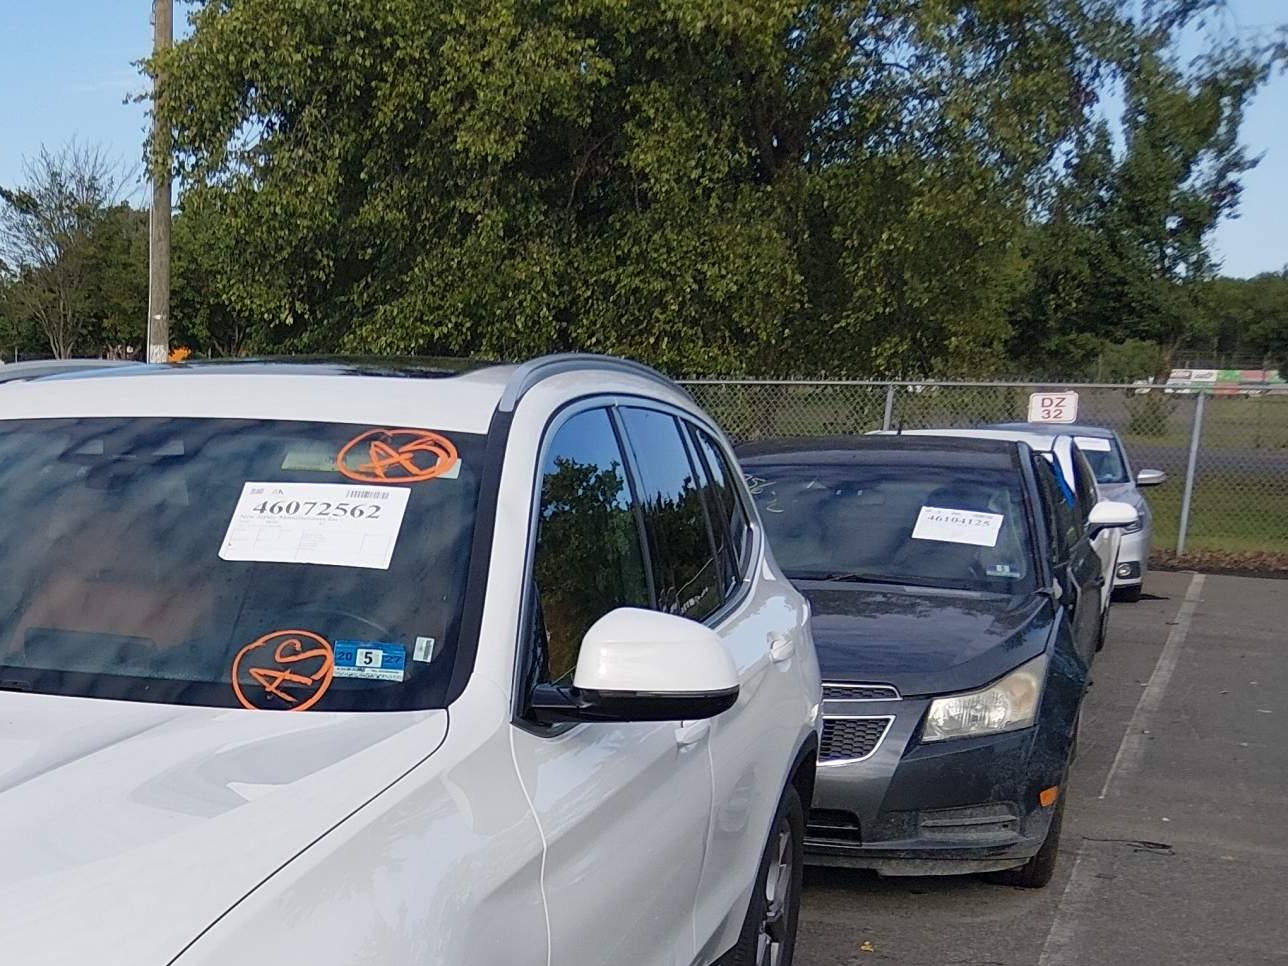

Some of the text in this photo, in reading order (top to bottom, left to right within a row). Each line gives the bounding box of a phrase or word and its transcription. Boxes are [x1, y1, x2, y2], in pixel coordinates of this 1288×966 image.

[1041, 397, 1066, 408] DZ
[1041, 409, 1063, 419] 32
[252, 500, 382, 519] 46072562
[337, 651, 353, 661] 20
[363, 651, 373, 665] 5
